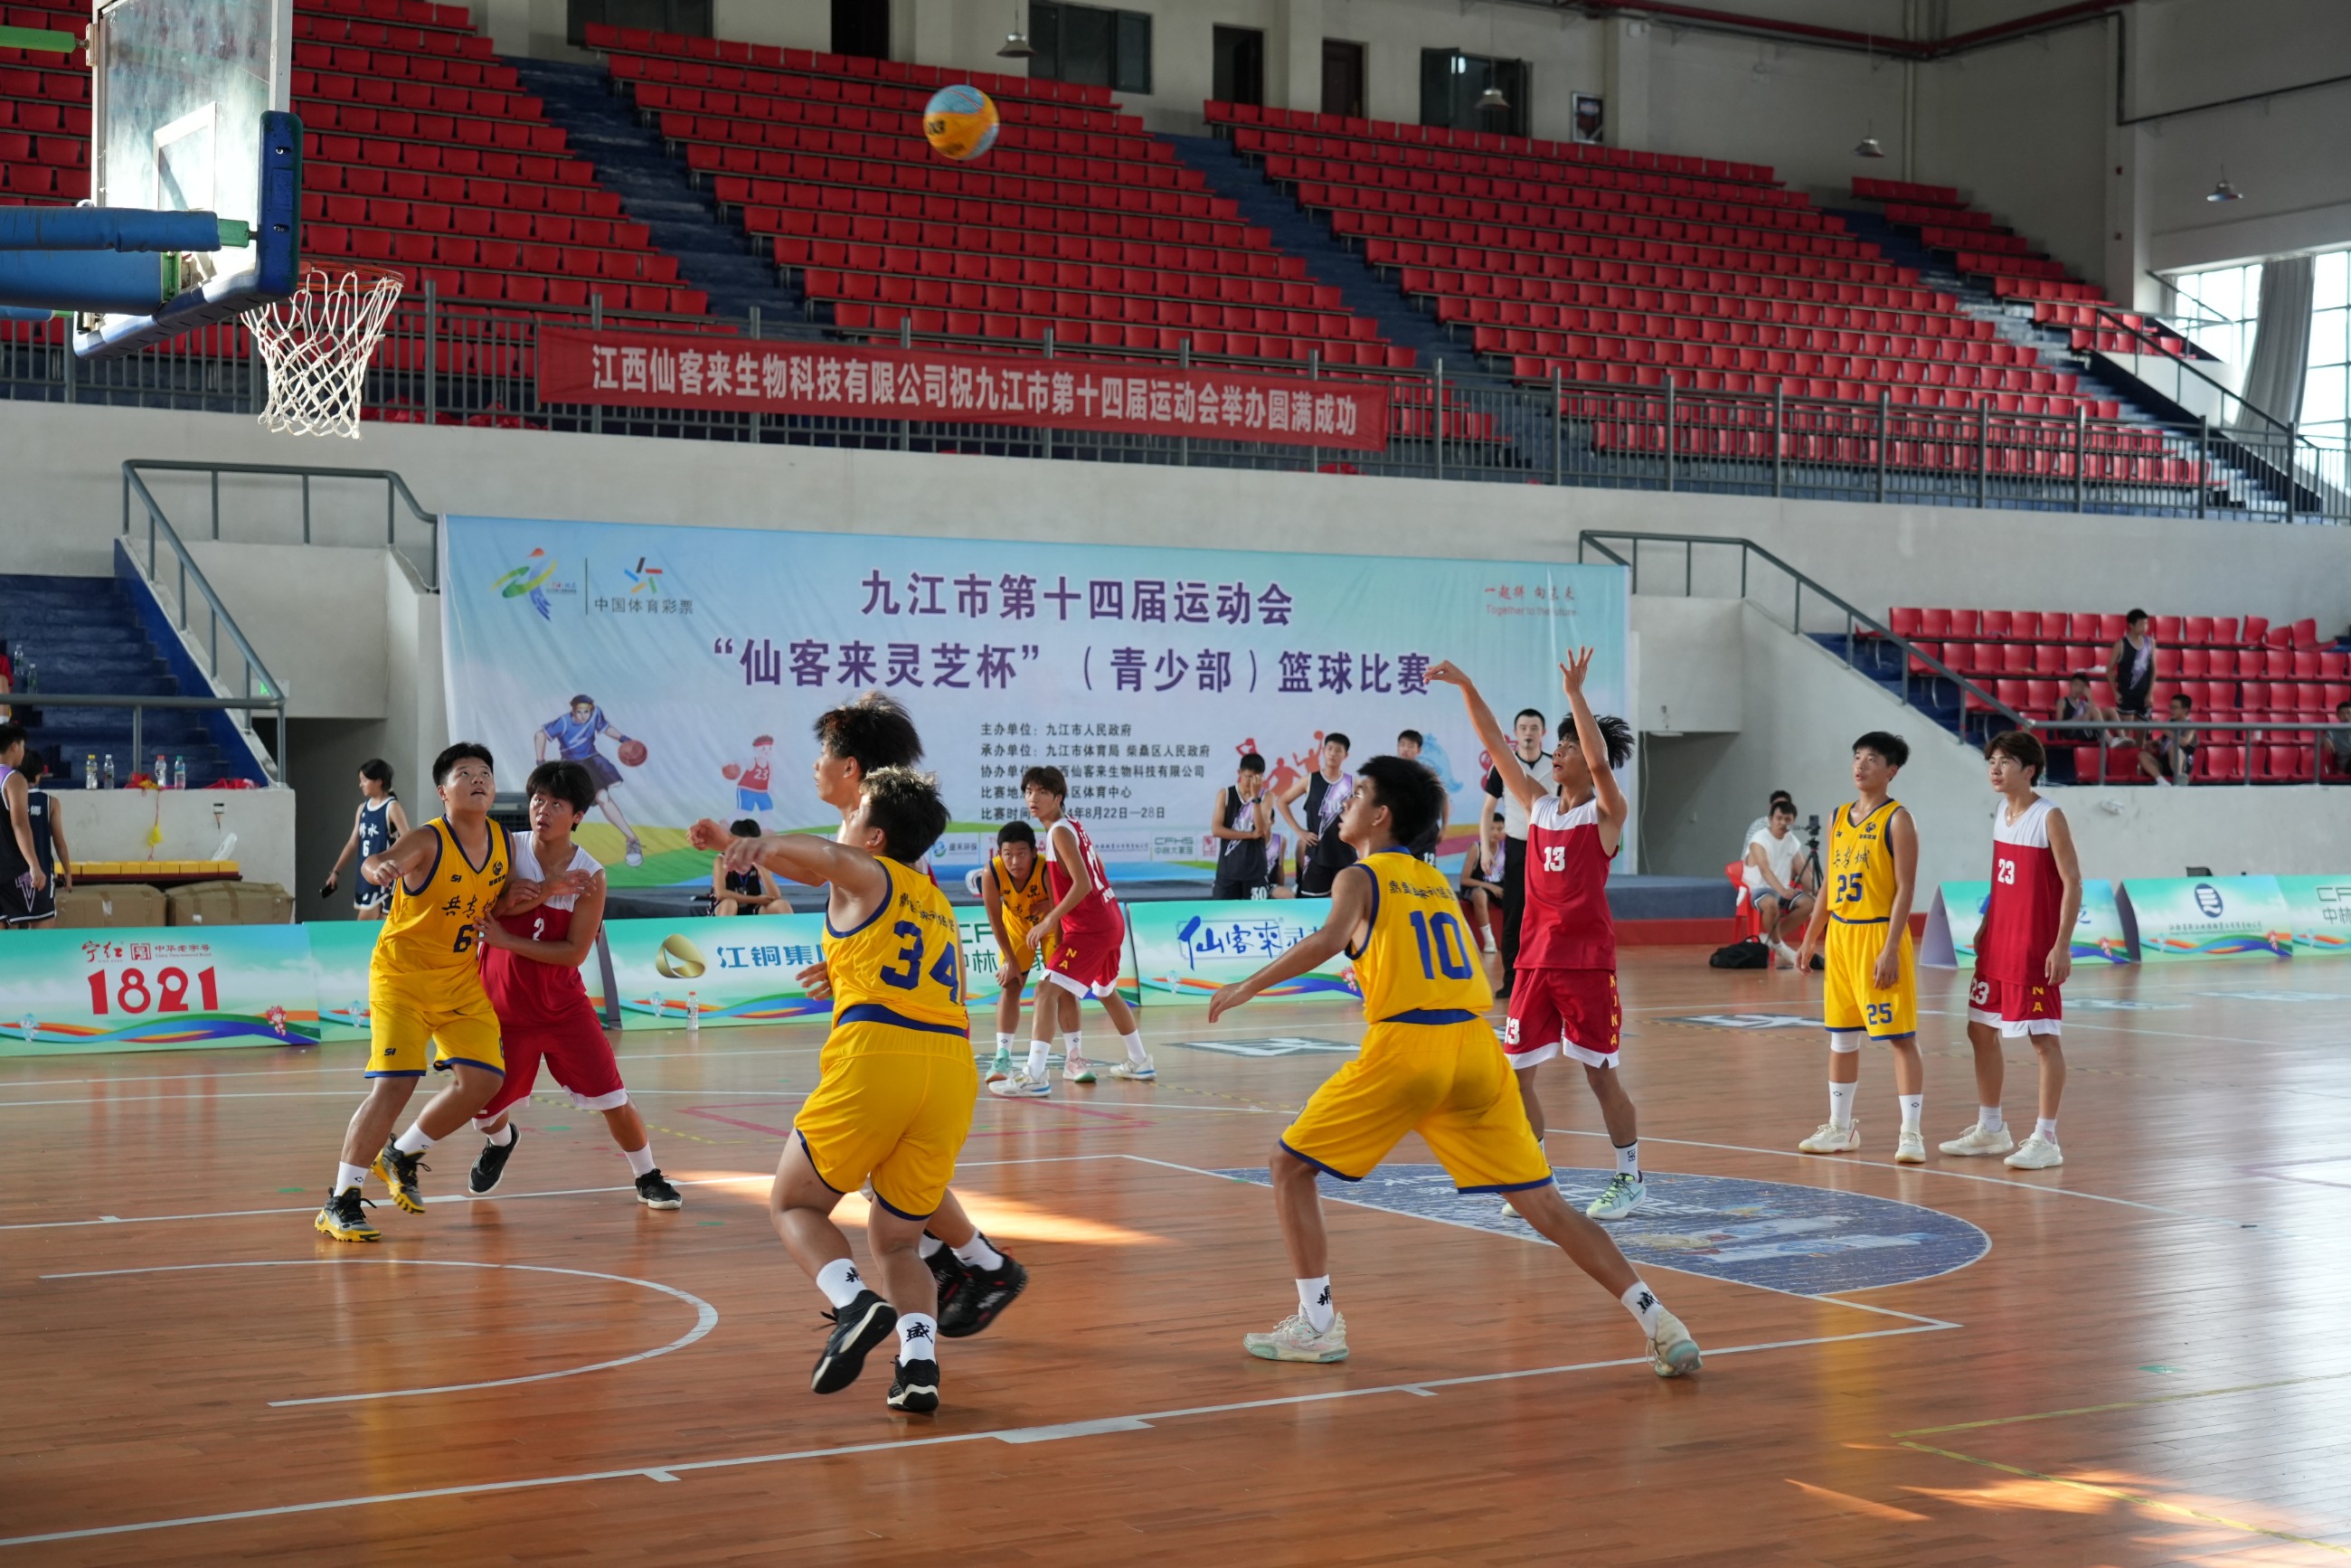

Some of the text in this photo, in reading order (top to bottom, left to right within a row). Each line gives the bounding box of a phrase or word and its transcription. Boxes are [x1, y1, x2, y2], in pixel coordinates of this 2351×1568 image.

[591, 344, 1357, 436] 江西仙客来生物科技有限公司祝九江市第十四届运动会举办圆满成功
[594, 596, 694, 615] 中国体育彩票
[861, 570, 1293, 626] 九江市第十四届运动会
[754, 769, 769, 780] 23
[363, 840, 370, 857] 6
[1543, 845, 1566, 872] 13
[1997, 858, 2016, 885] 23
[1836, 873, 1863, 903] 25
[453, 923, 475, 953] 6
[533, 918, 545, 940] 2
[716, 943, 825, 968] 江铜集
[1409, 910, 1473, 980] 10
[879, 920, 958, 1005] 34
[88, 966, 219, 1015] 1821
[1969, 978, 1989, 1006] 23
[1866, 1003, 1893, 1025] 25
[1504, 1015, 1520, 1045] 13
